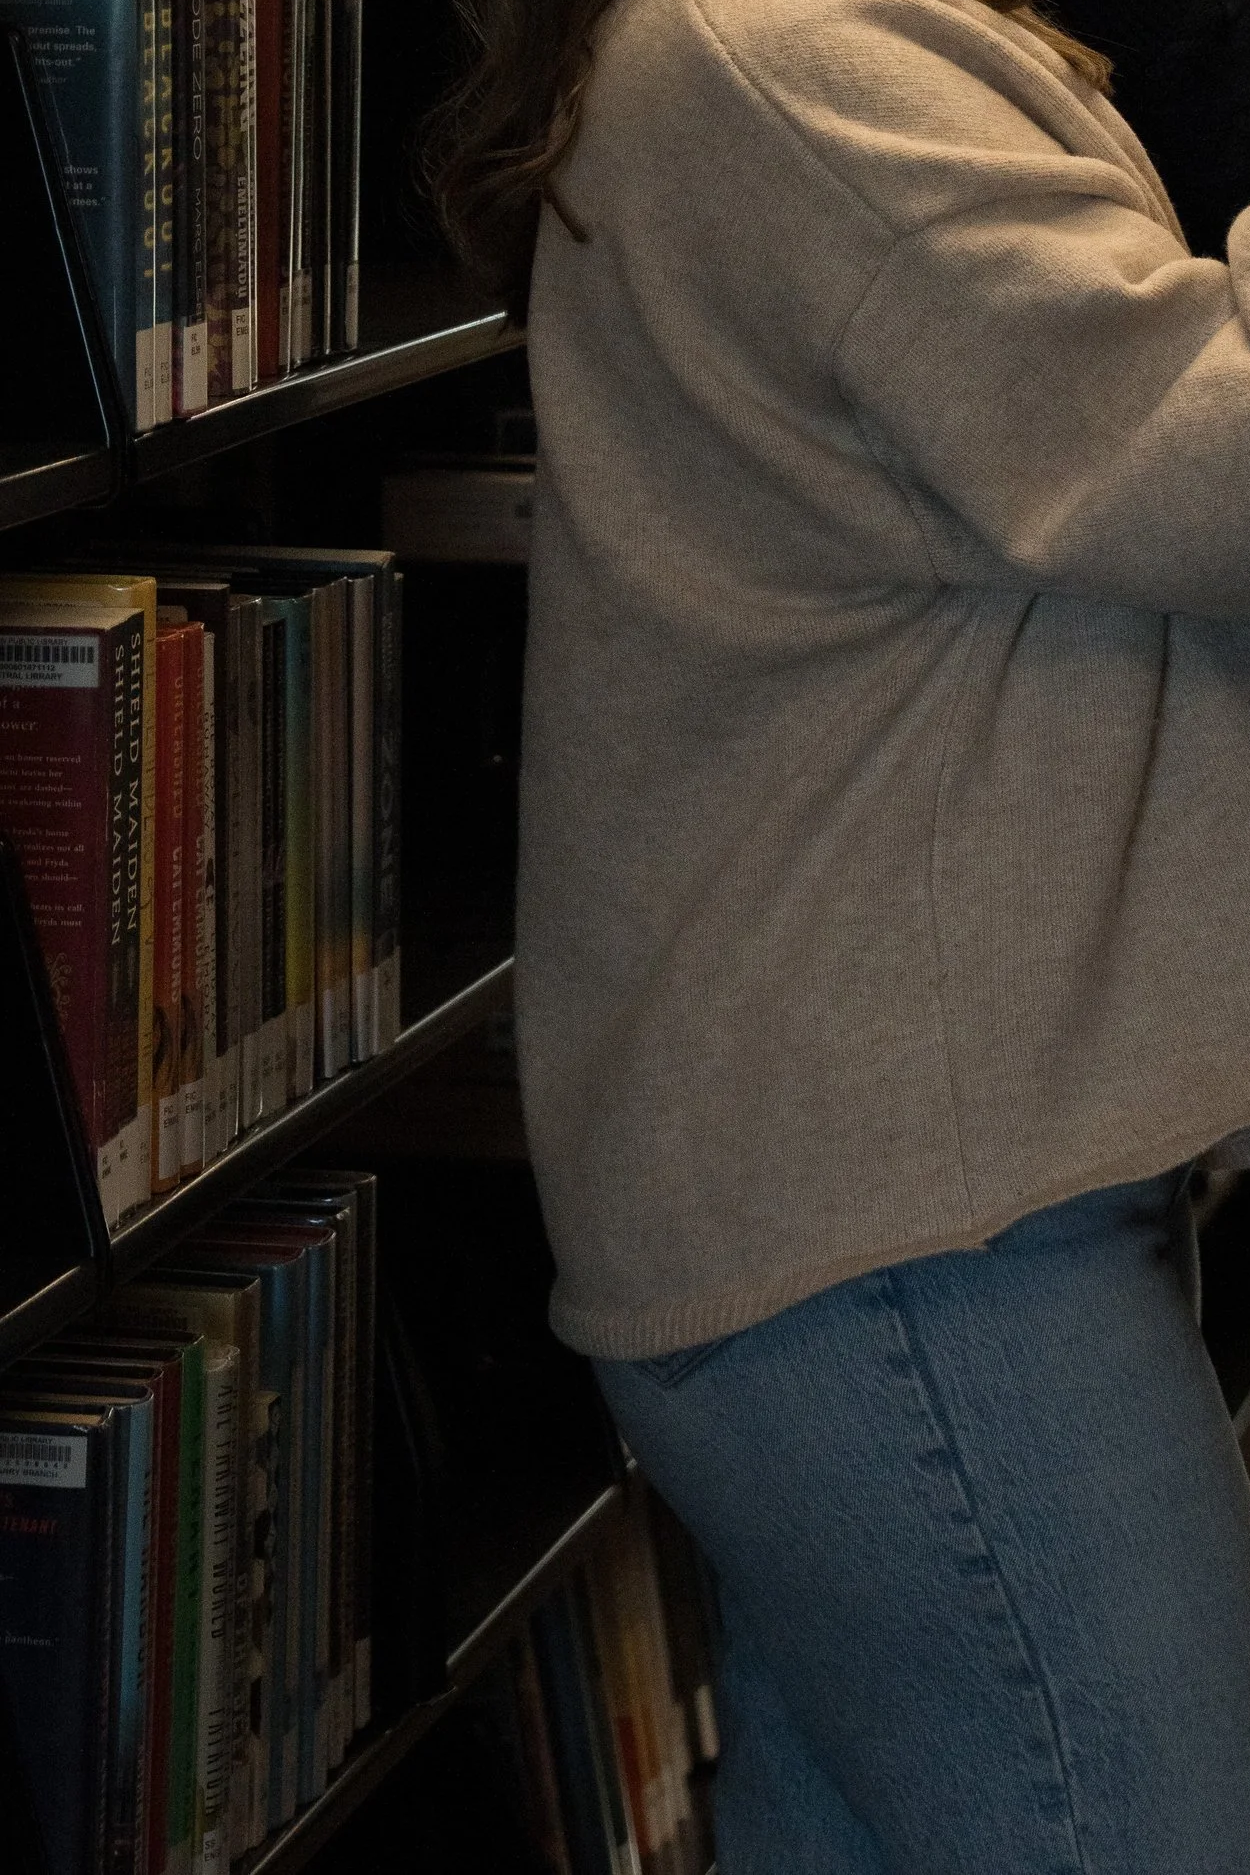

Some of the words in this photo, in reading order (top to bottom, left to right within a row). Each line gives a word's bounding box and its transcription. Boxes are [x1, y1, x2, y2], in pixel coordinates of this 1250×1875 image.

[76, 25, 96, 36] The
[53, 42, 97, 53] spreads,
[192, 71, 202, 160] ZERO
[64, 165, 98, 175] shows
[237, 176, 248, 299] EMELUMADU
[26, 672, 62, 680] LIBRARY
[129, 632, 141, 764] SHIELD
[114, 644, 125, 777] SHIELD
[17, 754, 43, 762] honor
[46, 754, 81, 763] reserved
[21, 768, 46, 777] leaves
[48, 769, 63, 778] her
[8, 798, 51, 808] awakening
[54, 799, 82, 808] within
[45, 828, 69, 837] home
[23, 843, 54, 852] realizes
[56, 844, 70, 852] not
[73, 844, 85, 852] all
[127, 777, 139, 932] MAIDEN
[26, 856, 42, 866] and
[45, 857, 69, 868] Fryda
[111, 791, 123, 947] MAIDEN
[60, 918, 82, 927] must
[171, 899, 182, 1005] EMMONS
